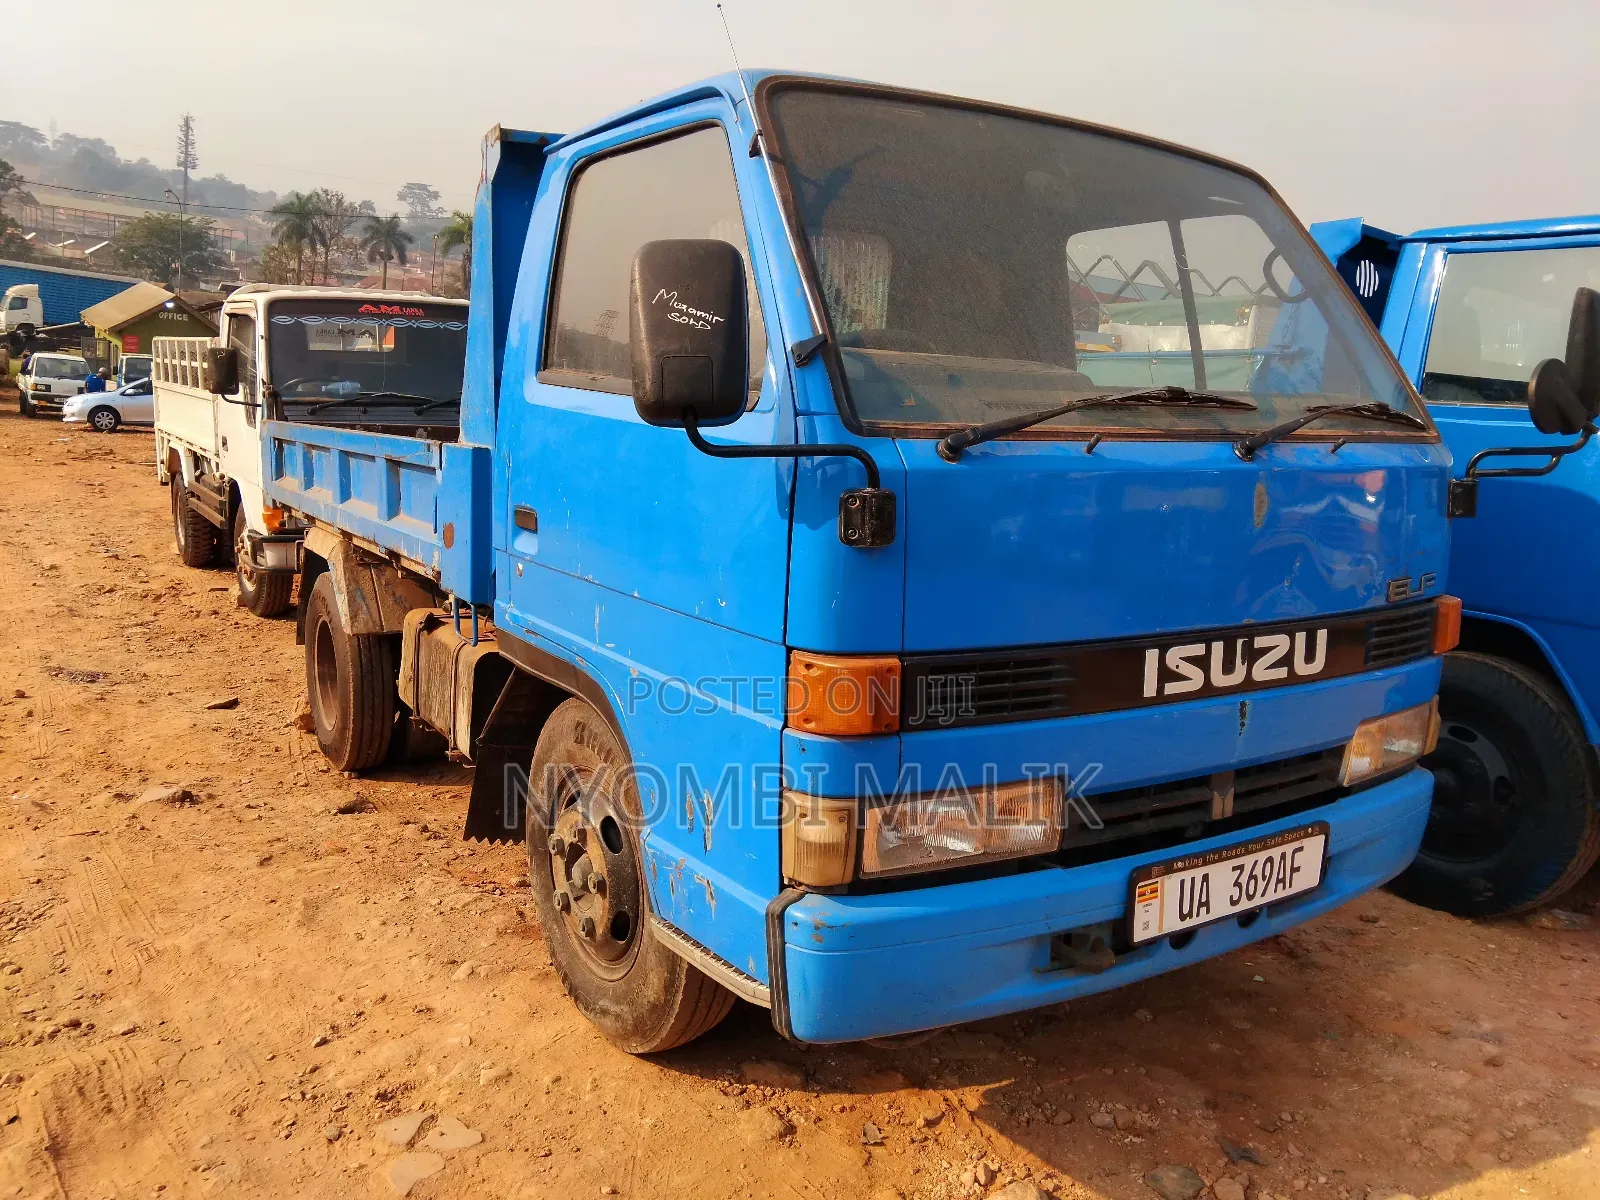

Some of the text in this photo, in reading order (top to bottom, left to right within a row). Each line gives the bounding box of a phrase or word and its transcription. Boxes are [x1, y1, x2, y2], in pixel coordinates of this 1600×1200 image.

[158, 311, 189, 321] OFFICE
[1143, 628, 1328, 698] ISUZU
[1206, 853, 1219, 862] the
[1266, 836, 1282, 846] Safe
[1284, 830, 1305, 841] Space
[1178, 846, 1305, 922] UA 369AF
